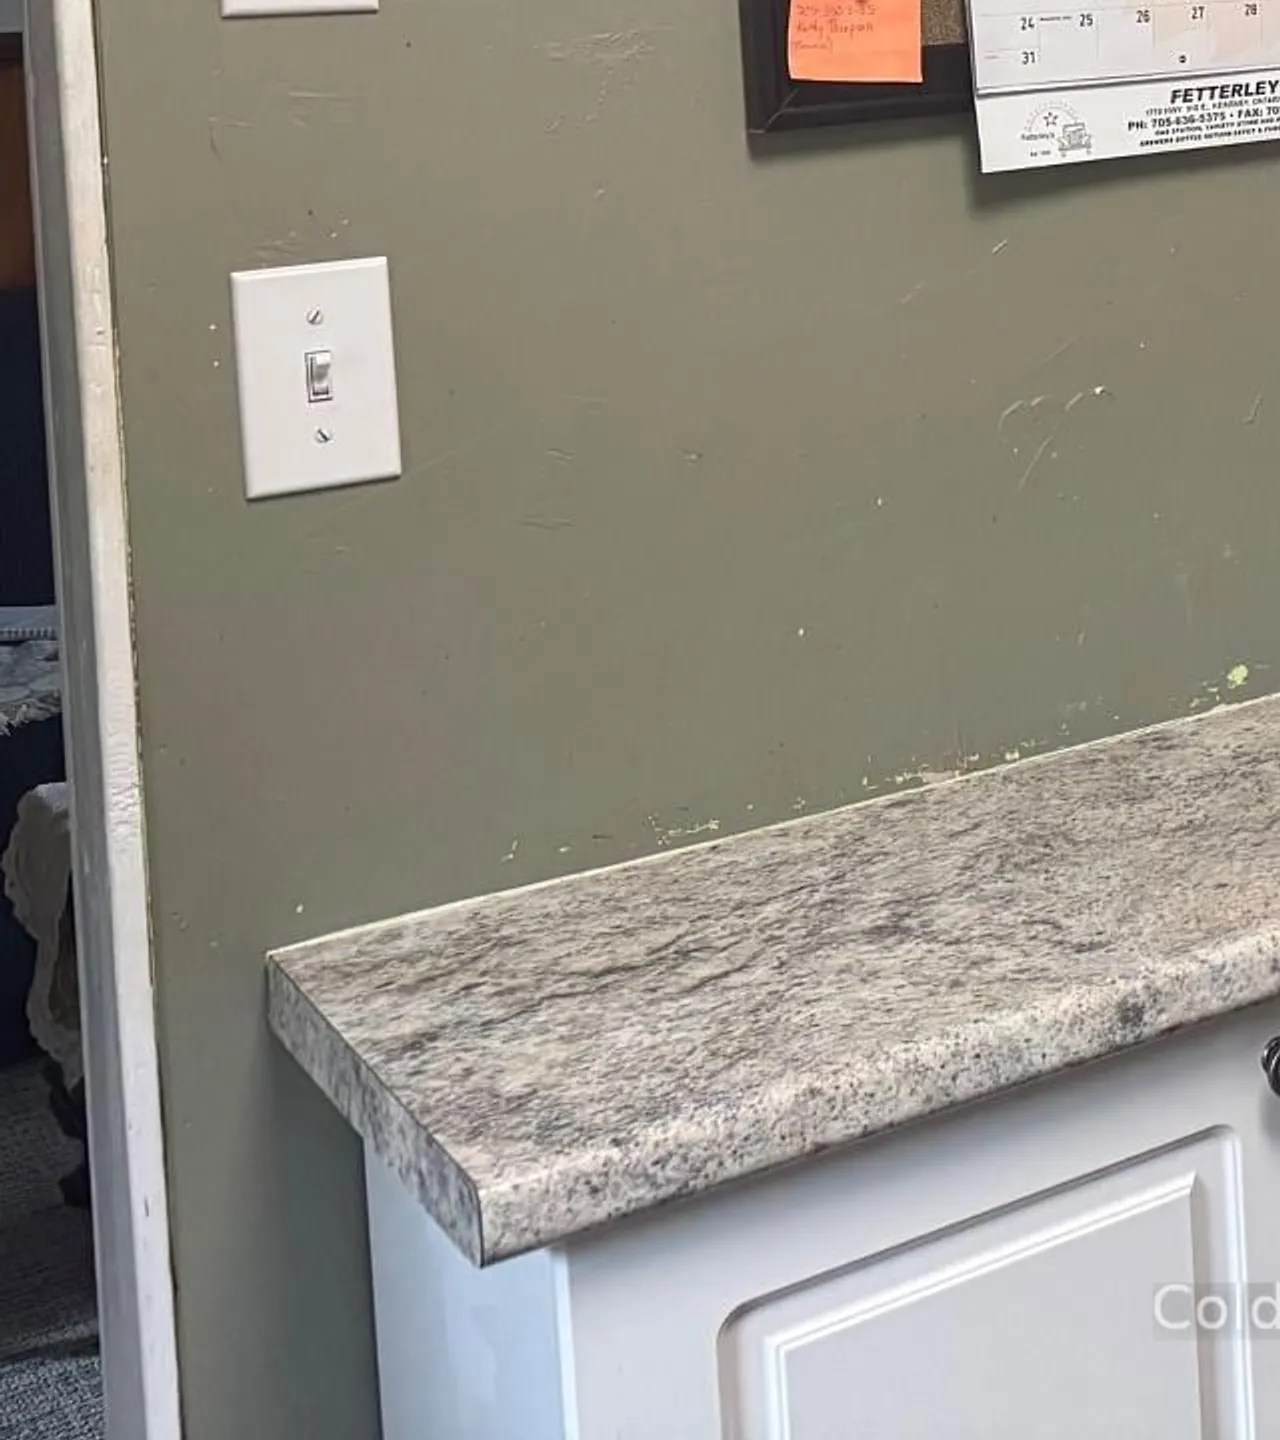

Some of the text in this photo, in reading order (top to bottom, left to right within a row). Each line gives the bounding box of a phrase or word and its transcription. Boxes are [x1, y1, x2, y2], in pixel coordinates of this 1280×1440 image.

[1020, 16, 1035, 31] 24
[1079, 13, 1094, 27] 25
[1136, 9, 1151, 24] 26
[1191, 5, 1206, 20] 27
[1244, 3, 1258, 17] 28
[1021, 51, 1036, 65] 31
[1127, 119, 1149, 132] PH:
[1237, 106, 1264, 120] FAX:
